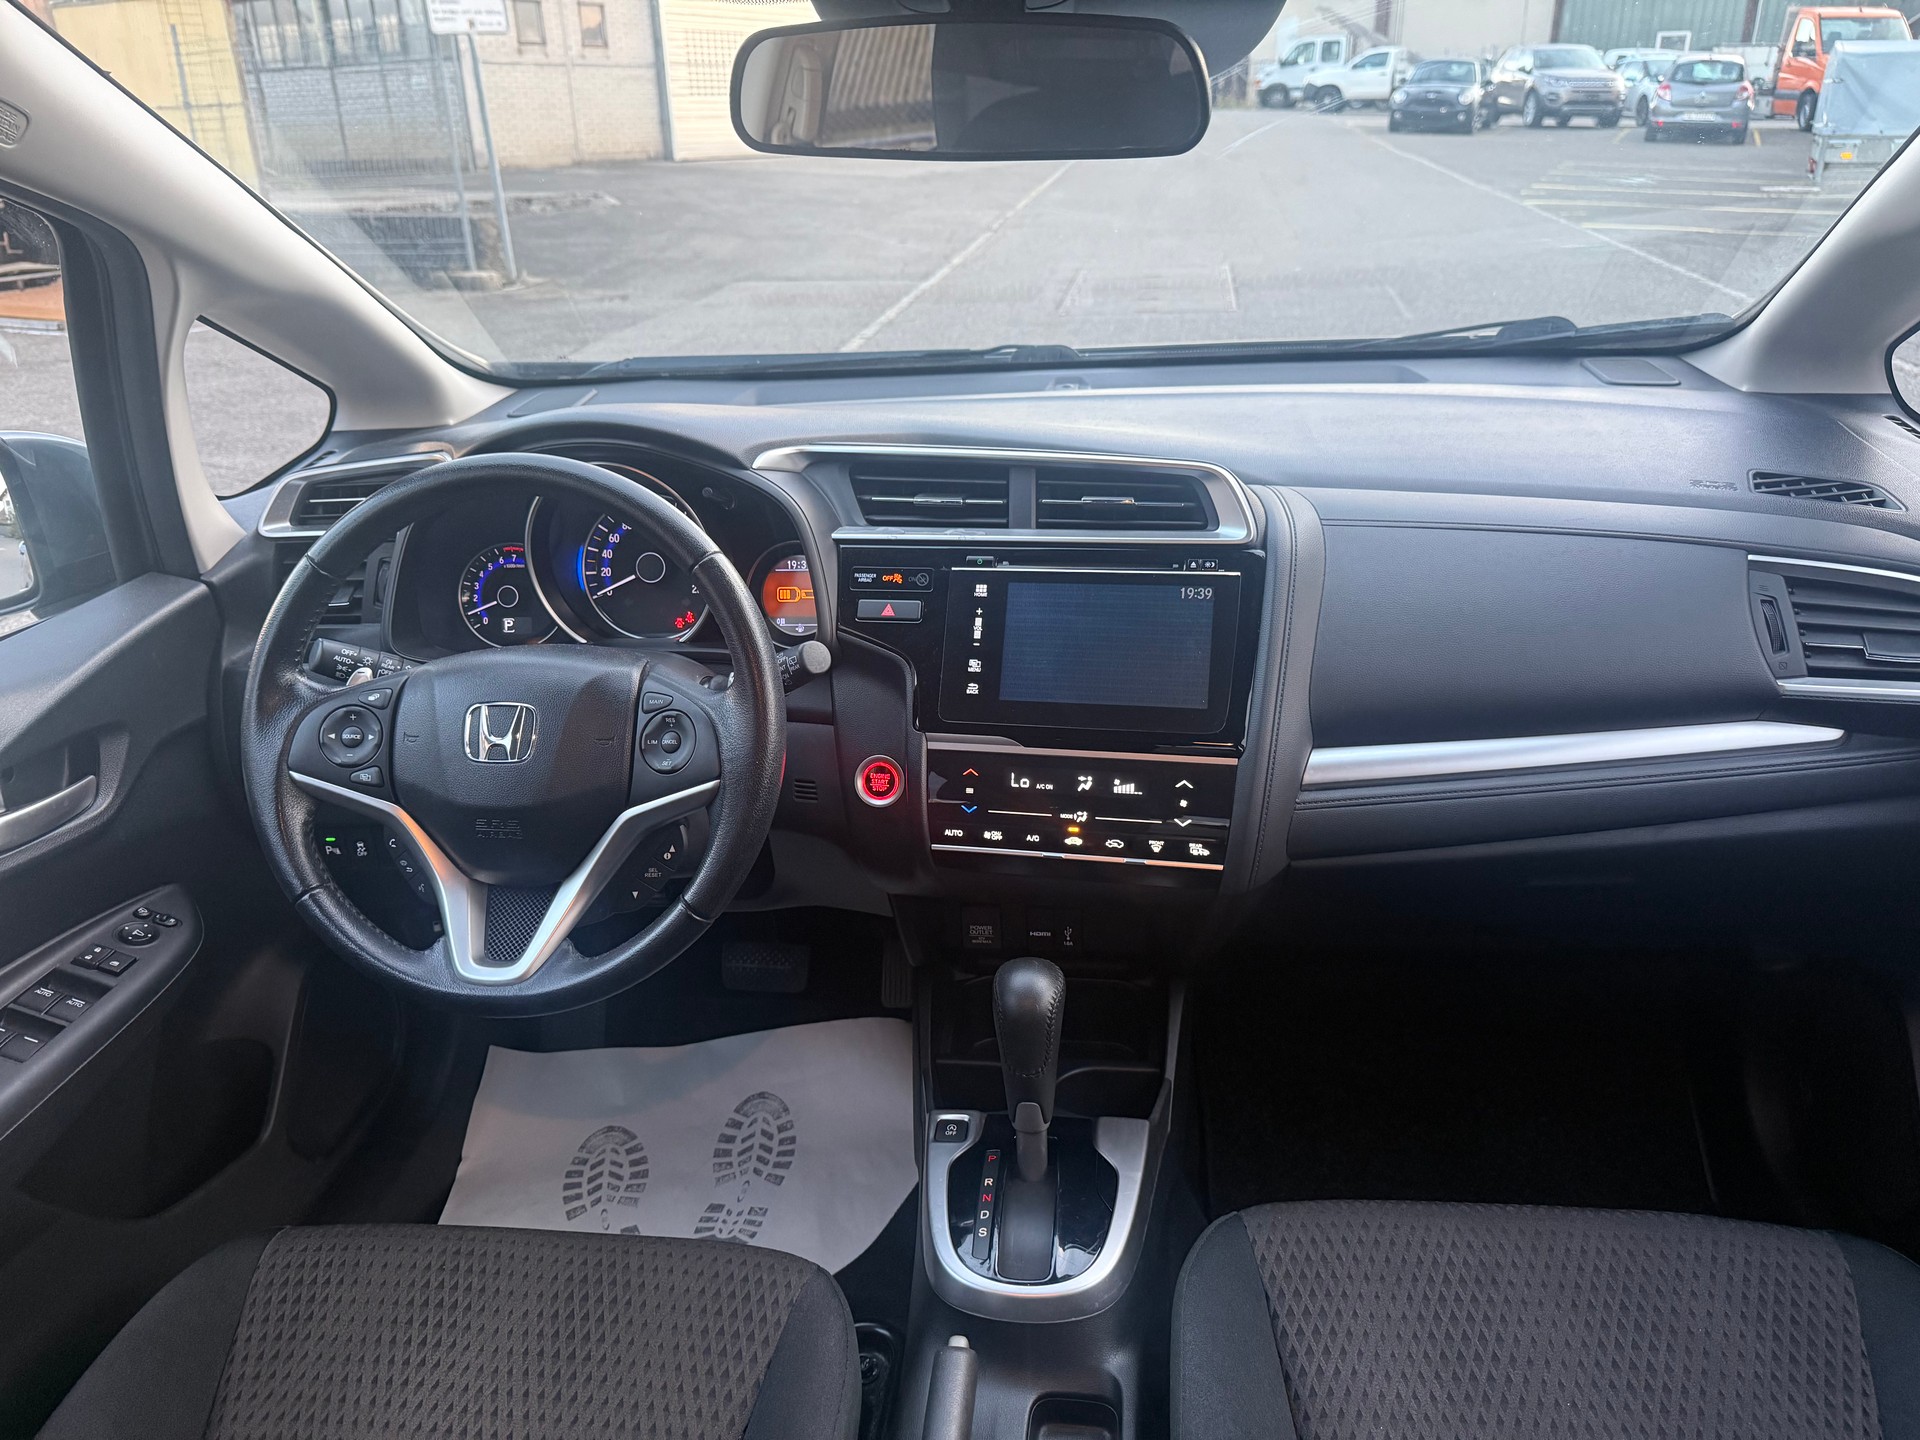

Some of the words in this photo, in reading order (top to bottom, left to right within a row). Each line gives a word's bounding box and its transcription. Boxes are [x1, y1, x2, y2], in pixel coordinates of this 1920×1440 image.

[608, 533, 620, 543] 60
[511, 554, 517, 562] 7
[601, 549, 613, 559] 40
[499, 556, 505, 564] 6
[786, 560, 807, 569] 19:3
[600, 567, 612, 577] 20
[474, 582, 480, 590] 3
[473, 594, 479, 602] 2
[1180, 587, 1213, 600] 19:39
[482, 617, 489, 625] 0
[341, 648, 354, 657] OFF
[333, 655, 352, 664] AUTO
[944, 829, 964, 837] AUTO
[34, 989, 52, 997] AUTO
[66, 1000, 83, 1008] AUTO
[984, 1178, 994, 1187] R
[982, 1194, 992, 1202] N
[980, 1210, 990, 1219] D
[978, 1227, 988, 1237] S
